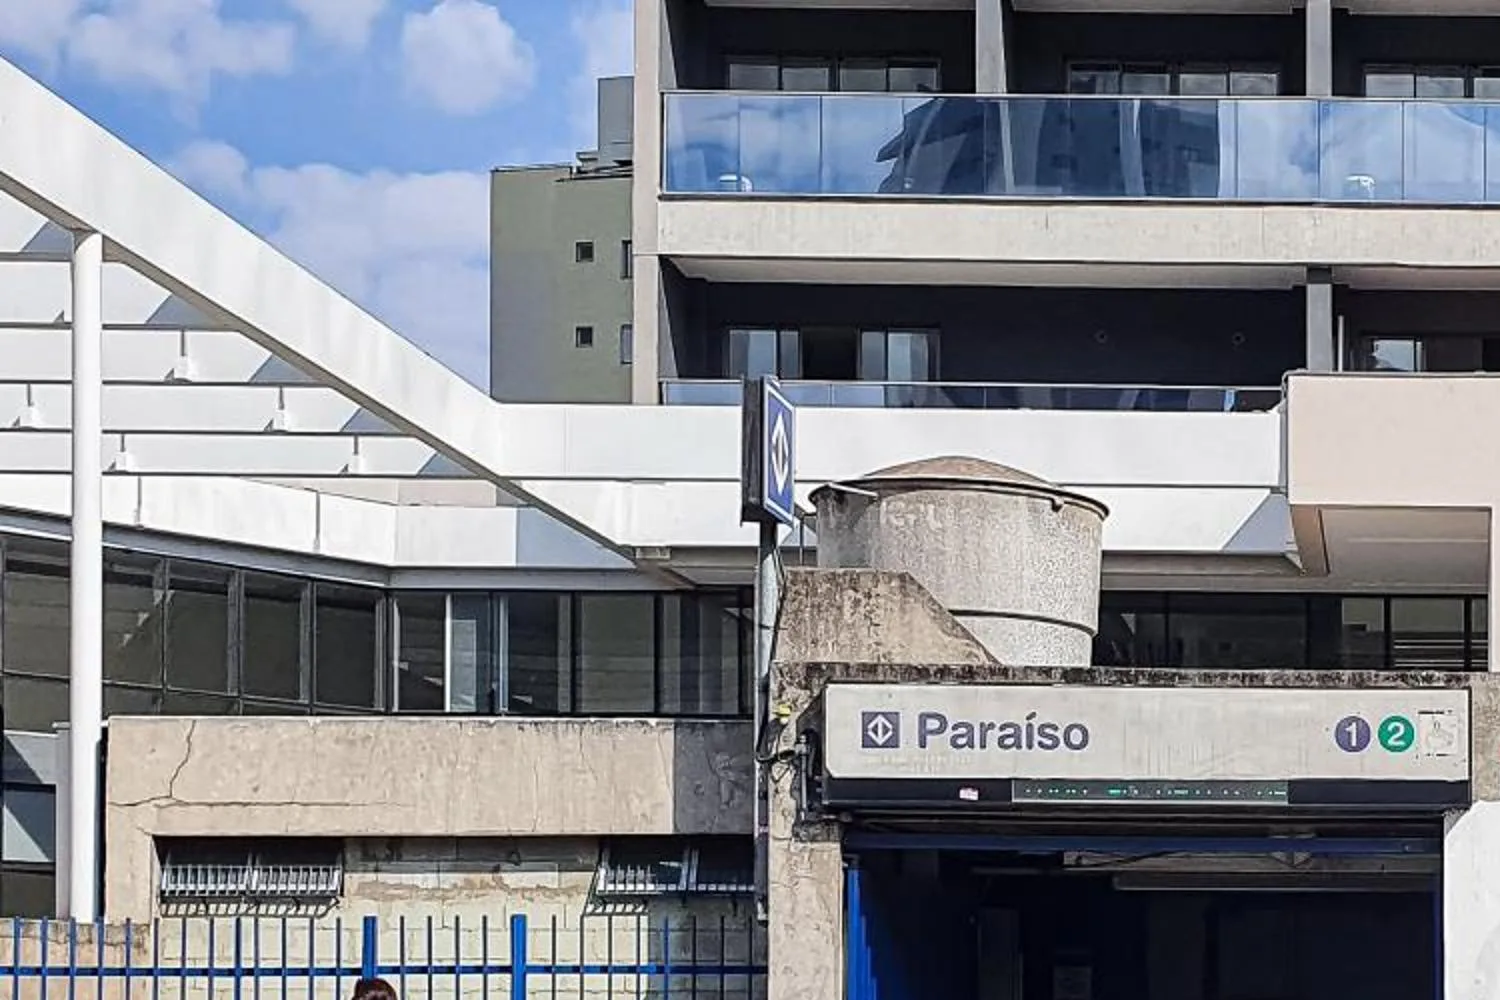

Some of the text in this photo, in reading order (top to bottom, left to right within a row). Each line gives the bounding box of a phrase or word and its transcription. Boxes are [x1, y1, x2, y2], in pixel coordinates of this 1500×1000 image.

[917, 711, 1089, 750] Paraíso
[1345, 721, 1406, 748] 1 2
